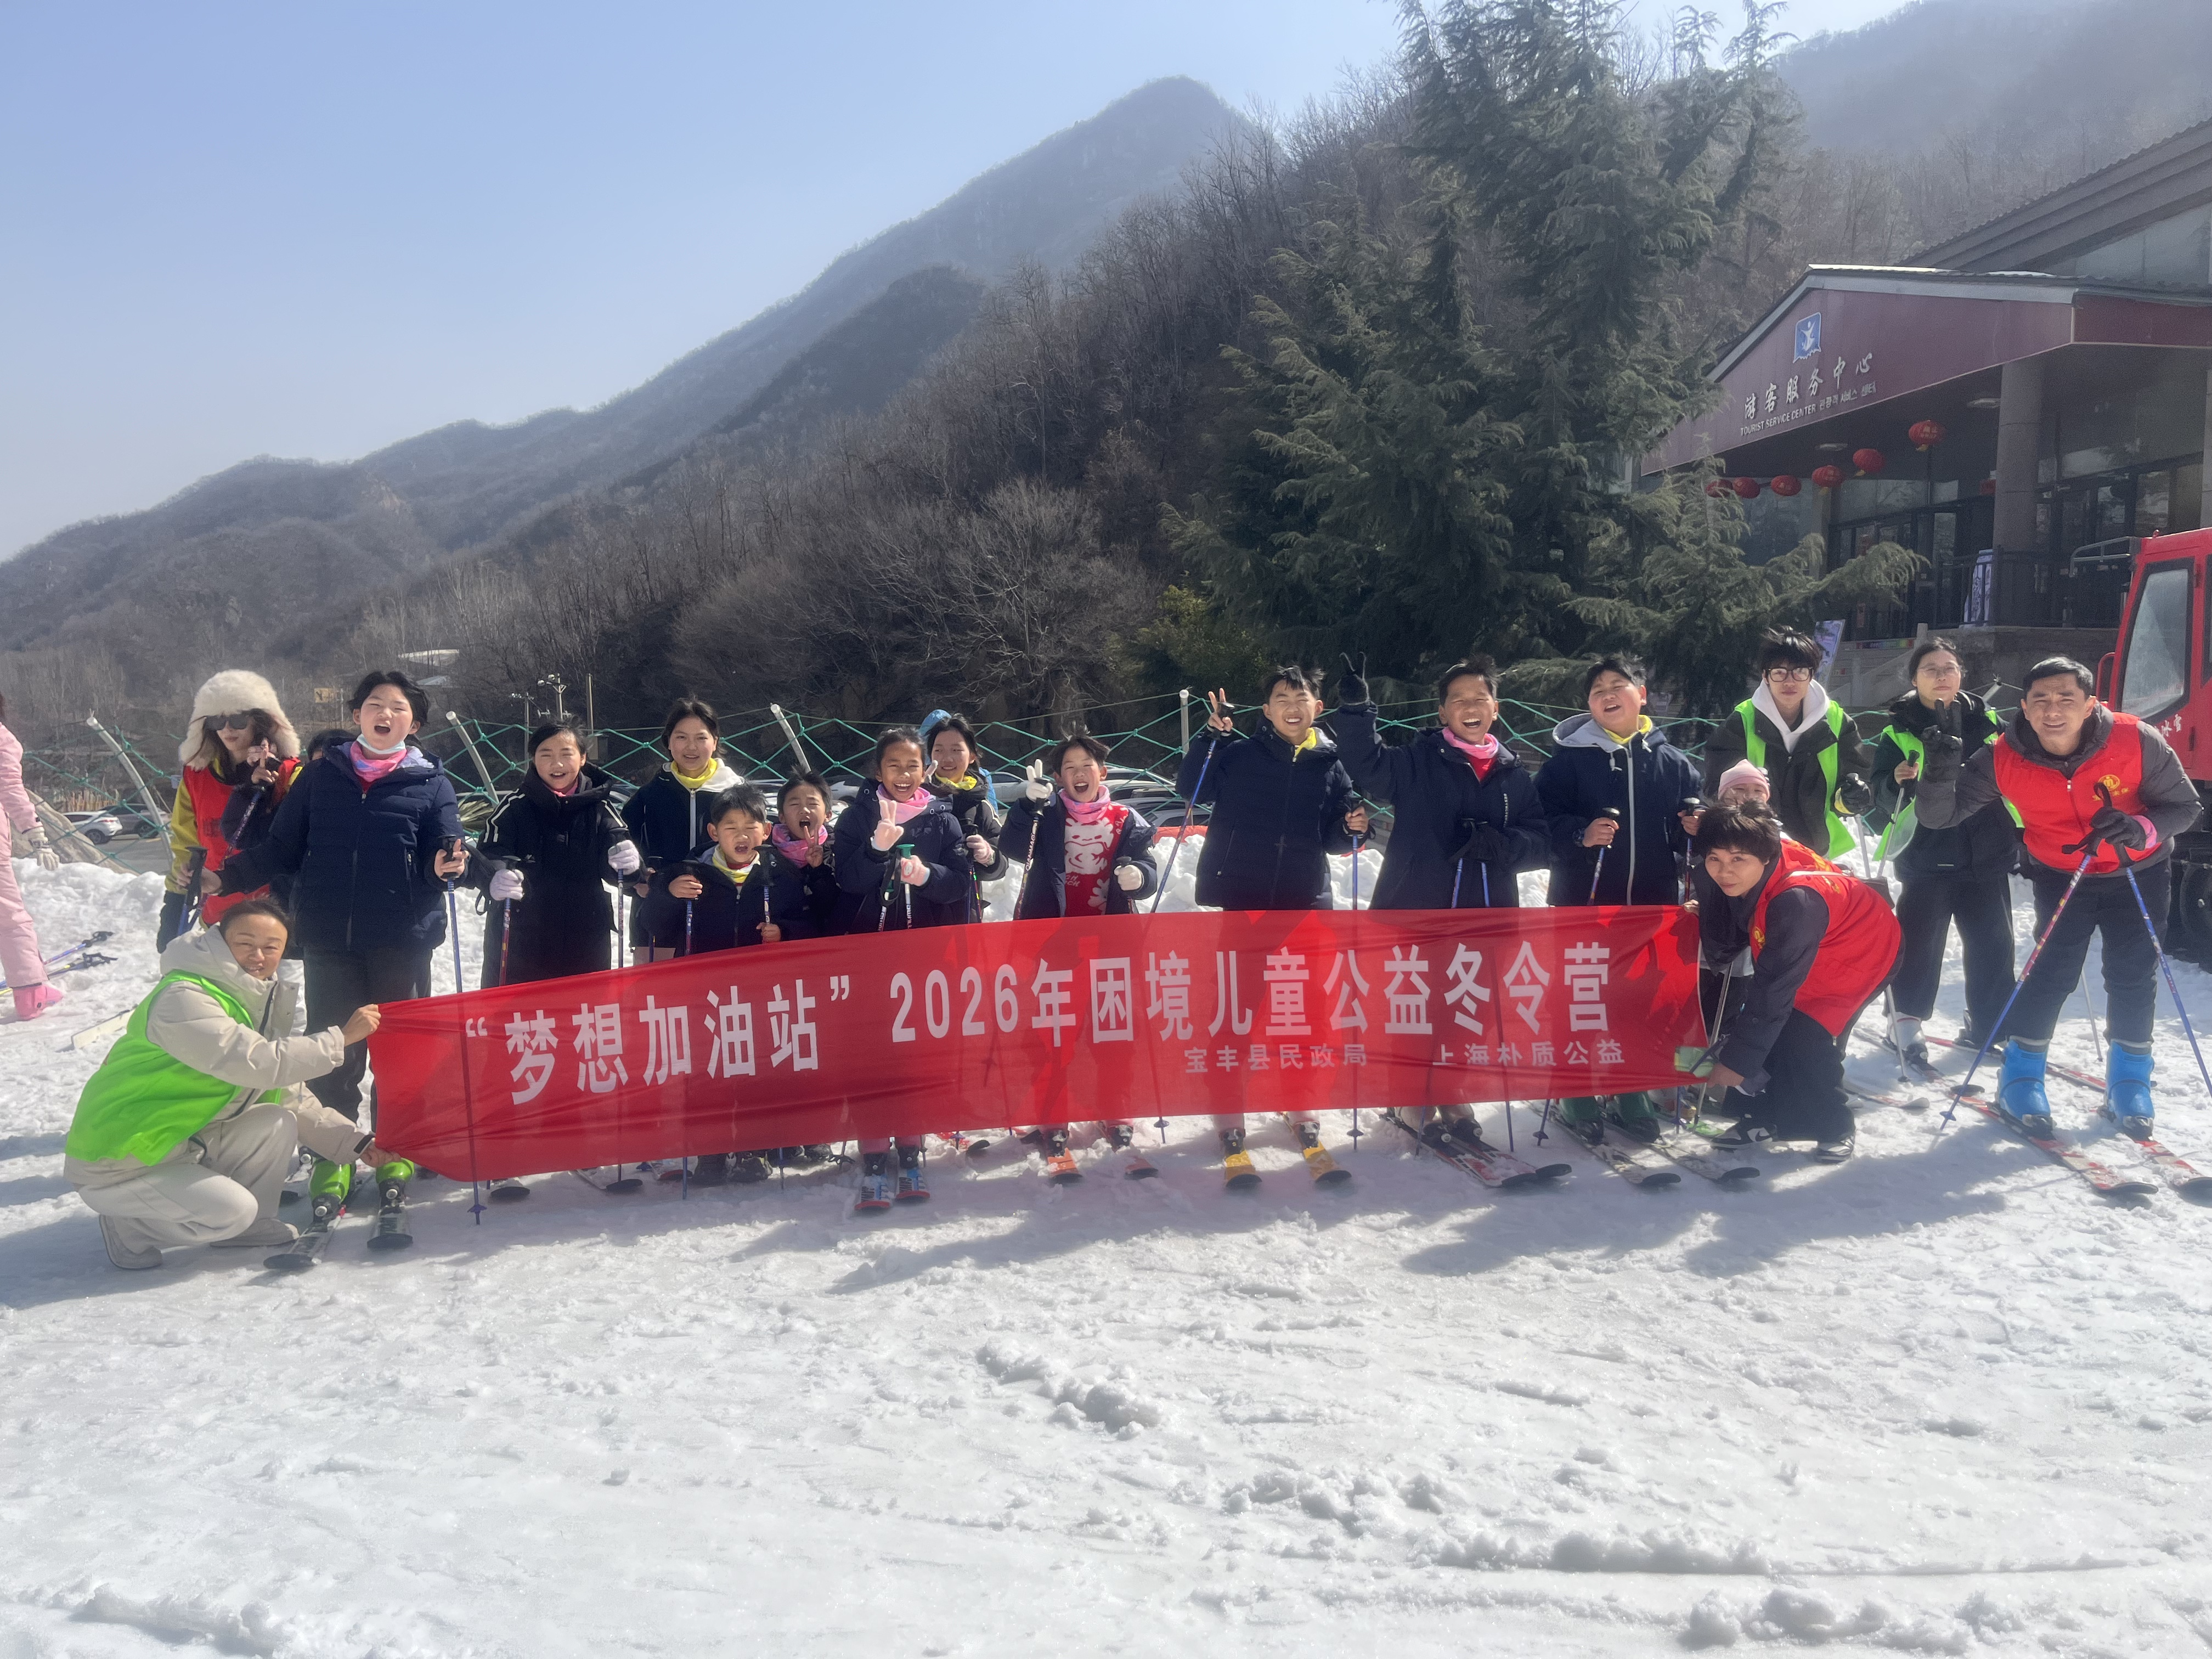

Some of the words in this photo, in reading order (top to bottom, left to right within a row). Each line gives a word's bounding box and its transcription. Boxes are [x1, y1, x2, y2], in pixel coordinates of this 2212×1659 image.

[1741, 420, 1765, 436] TOURIST
[1766, 413, 1790, 428] SERVICE
[1791, 404, 1816, 420] CENTER
[1840, 389, 1858, 403] 서비스
[1861, 381, 1877, 397] 센터
[1745, 352, 1872, 420] 游客服务中心
[465, 975, 850, 1105] “梦想加油站”
[890, 940, 1610, 1047] 2026年困境儿童公益冬令营
[1184, 1043, 1367, 1073] 宝丰县民政局
[1432, 1039, 1625, 1066] 上海朴质公益
